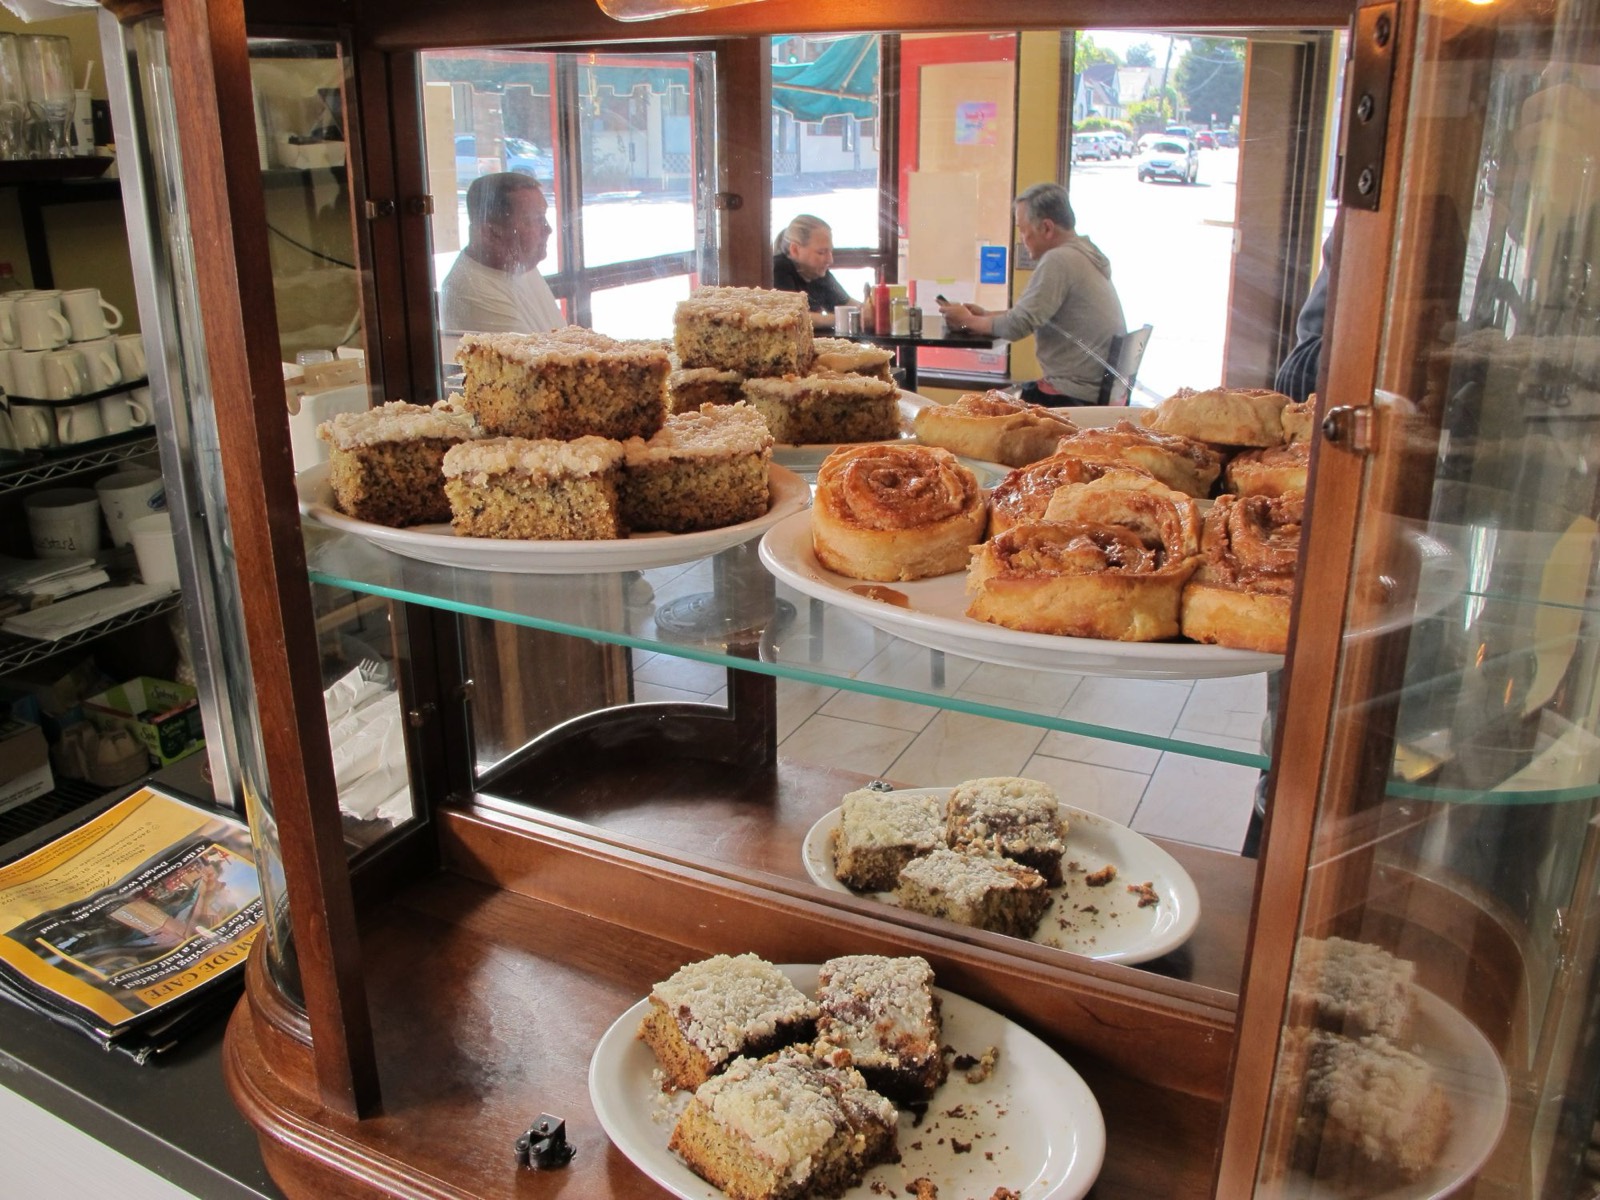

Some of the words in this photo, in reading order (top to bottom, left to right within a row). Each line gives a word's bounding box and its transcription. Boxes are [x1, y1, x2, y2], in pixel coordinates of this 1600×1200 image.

[181, 851, 198, 863] the
[85, 871, 111, 886] Friday
[137, 861, 169, 881] Dwight
[152, 861, 184, 881] Corner
[116, 880, 139, 895] Way
[141, 879, 154, 888] of
[227, 914, 246, 926] for
[39, 922, 60, 934] and
[219, 919, 256, 943] legend
[159, 953, 184, 968] half
[176, 942, 219, 966] serving
[109, 964, 159, 986] century!
[122, 965, 180, 989] breakfast
